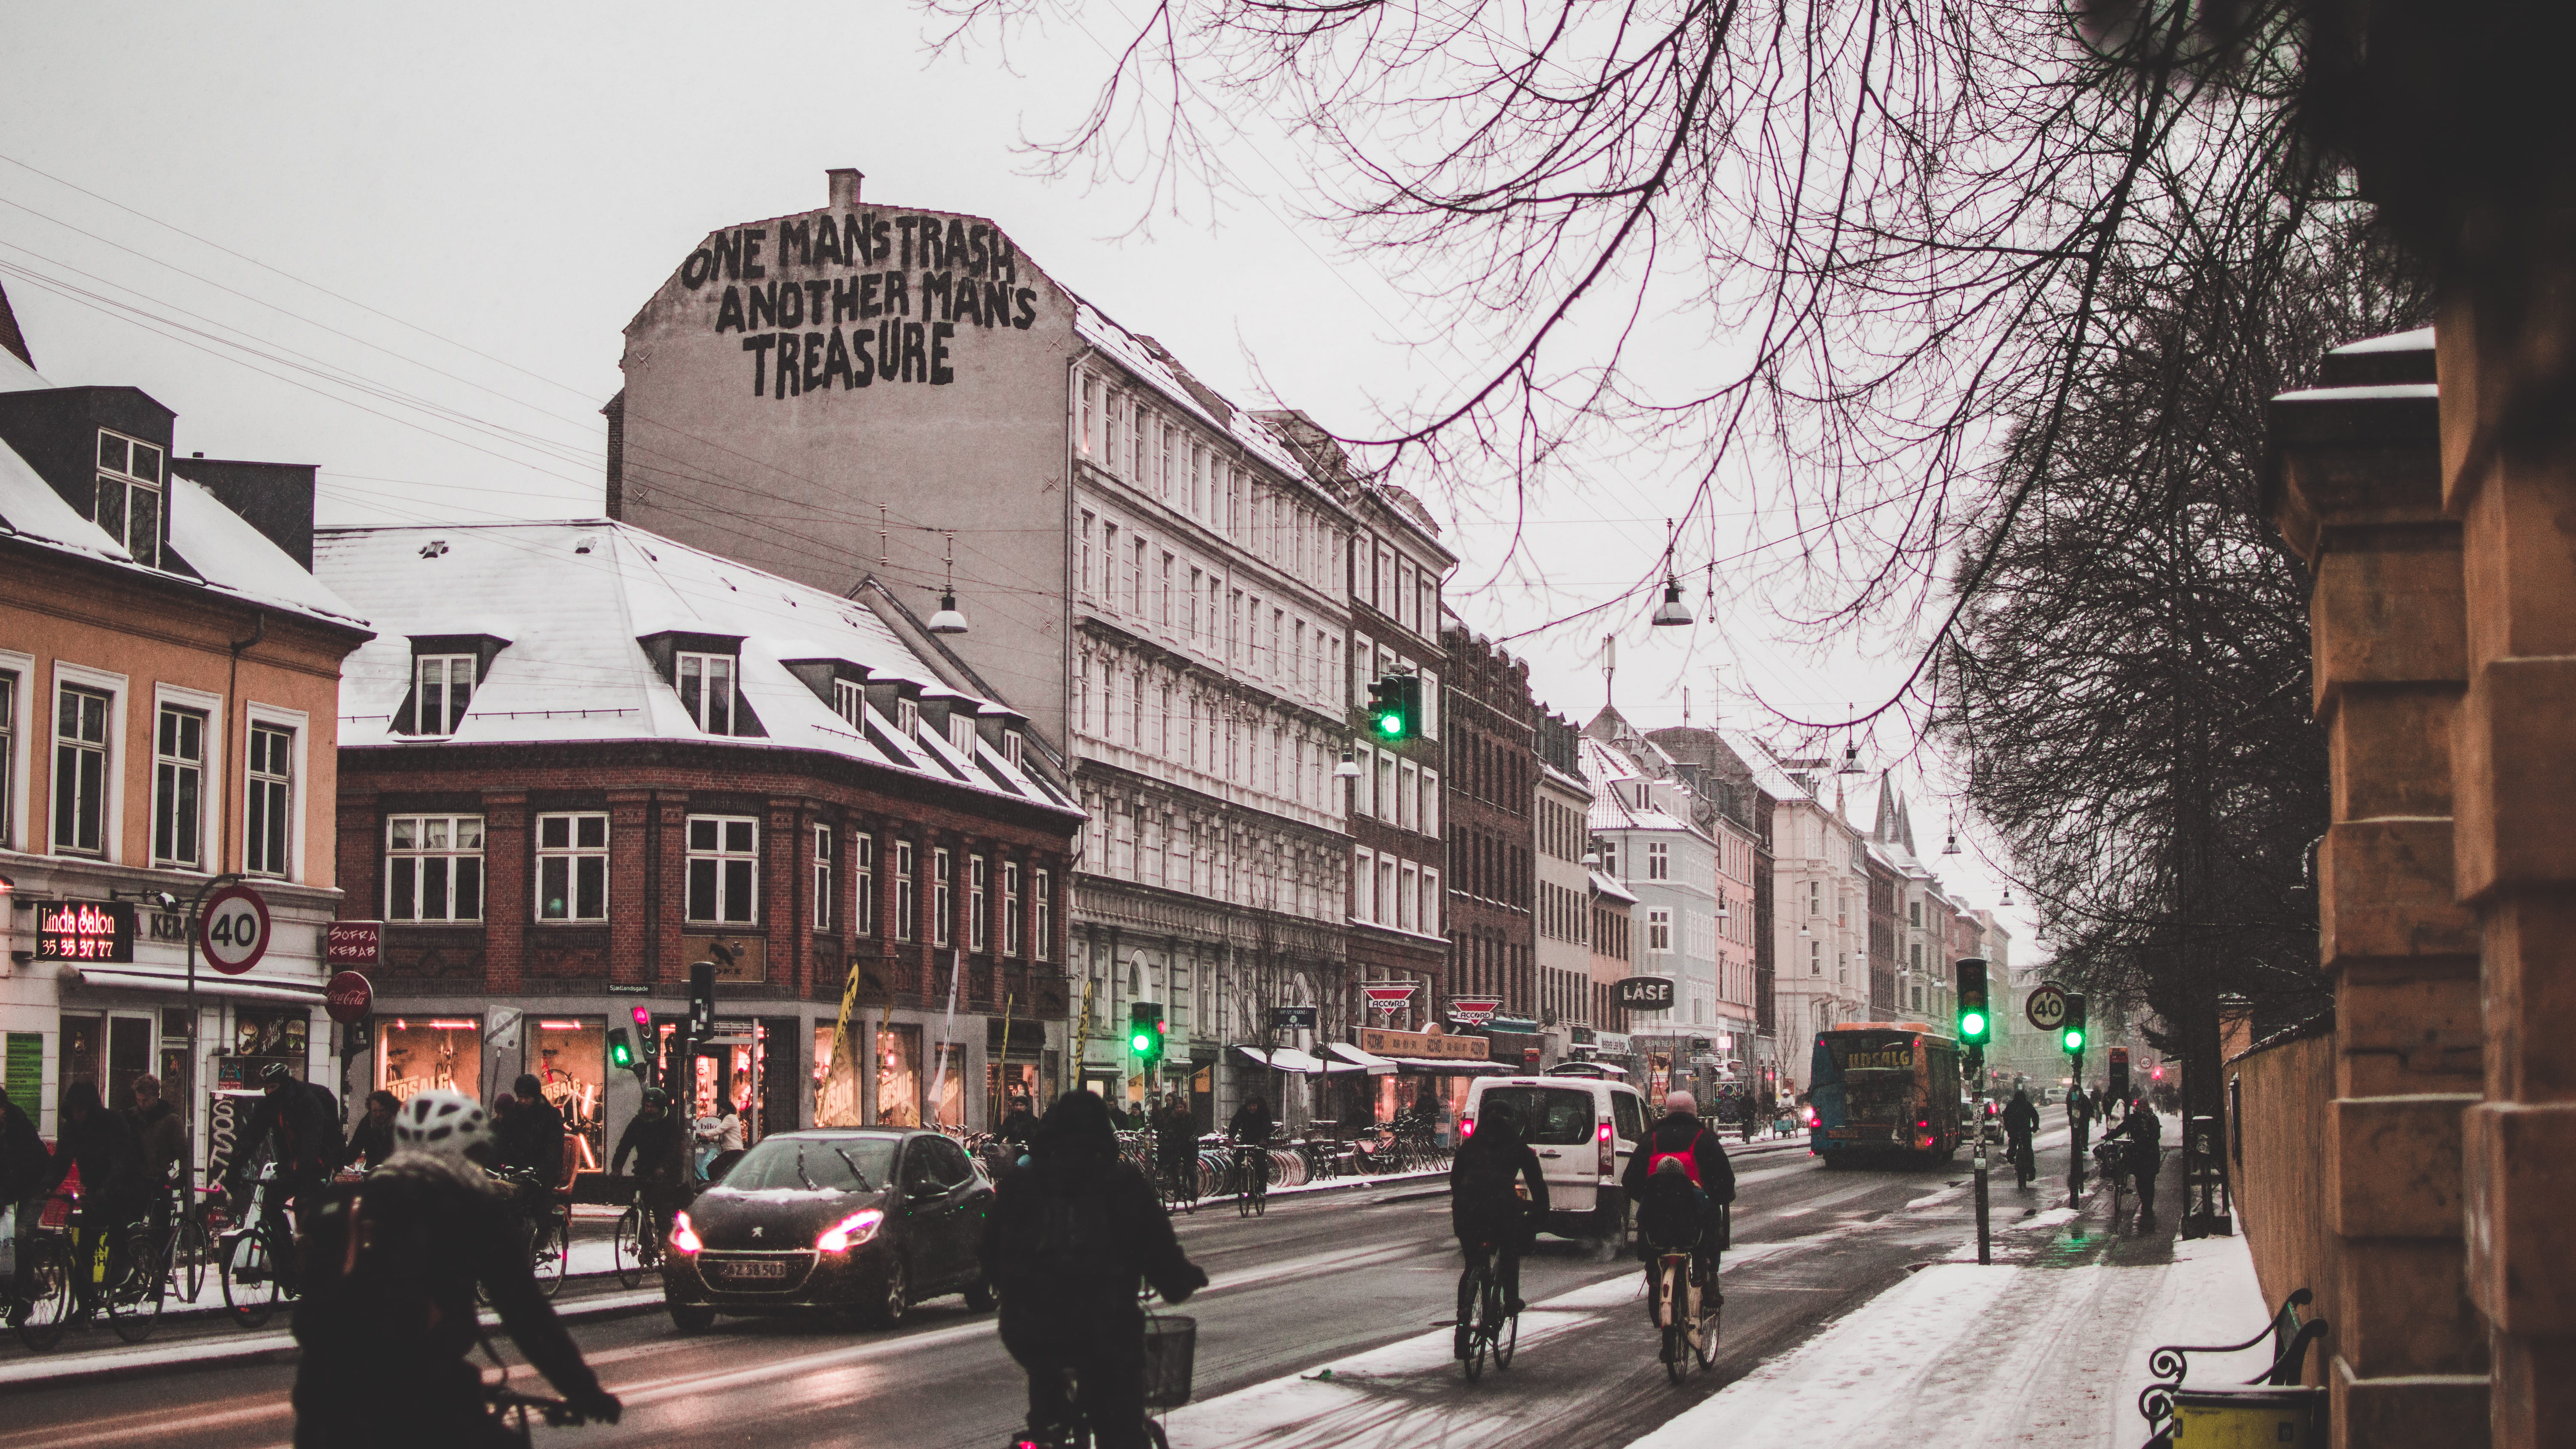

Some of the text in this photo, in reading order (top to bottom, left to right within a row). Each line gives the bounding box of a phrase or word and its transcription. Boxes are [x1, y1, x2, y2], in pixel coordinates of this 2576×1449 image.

[681, 212, 1016, 290] ONE MAN'S TRASH
[715, 270, 1037, 333] ANOTHER MAN'S
[742, 317, 955, 400] TREASURE
[42, 905, 76, 934] Linda
[78, 905, 115, 934] Salon
[150, 913, 200, 940] KEB
[211, 913, 256, 947] 40
[329, 926, 377, 941] SOFRA
[42, 939, 113, 957] 35 35 37 77
[329, 945, 376, 957] KEBAB
[1623, 983, 1669, 1000] LÅSE
[2034, 1000, 2062, 1017] 40
[267, 1016, 284, 1037] Sofra
[260, 1030, 281, 1055] Kebab
[1848, 1051, 1909, 1068] UDSALG
[542, 1079, 581, 1100] DSALG
